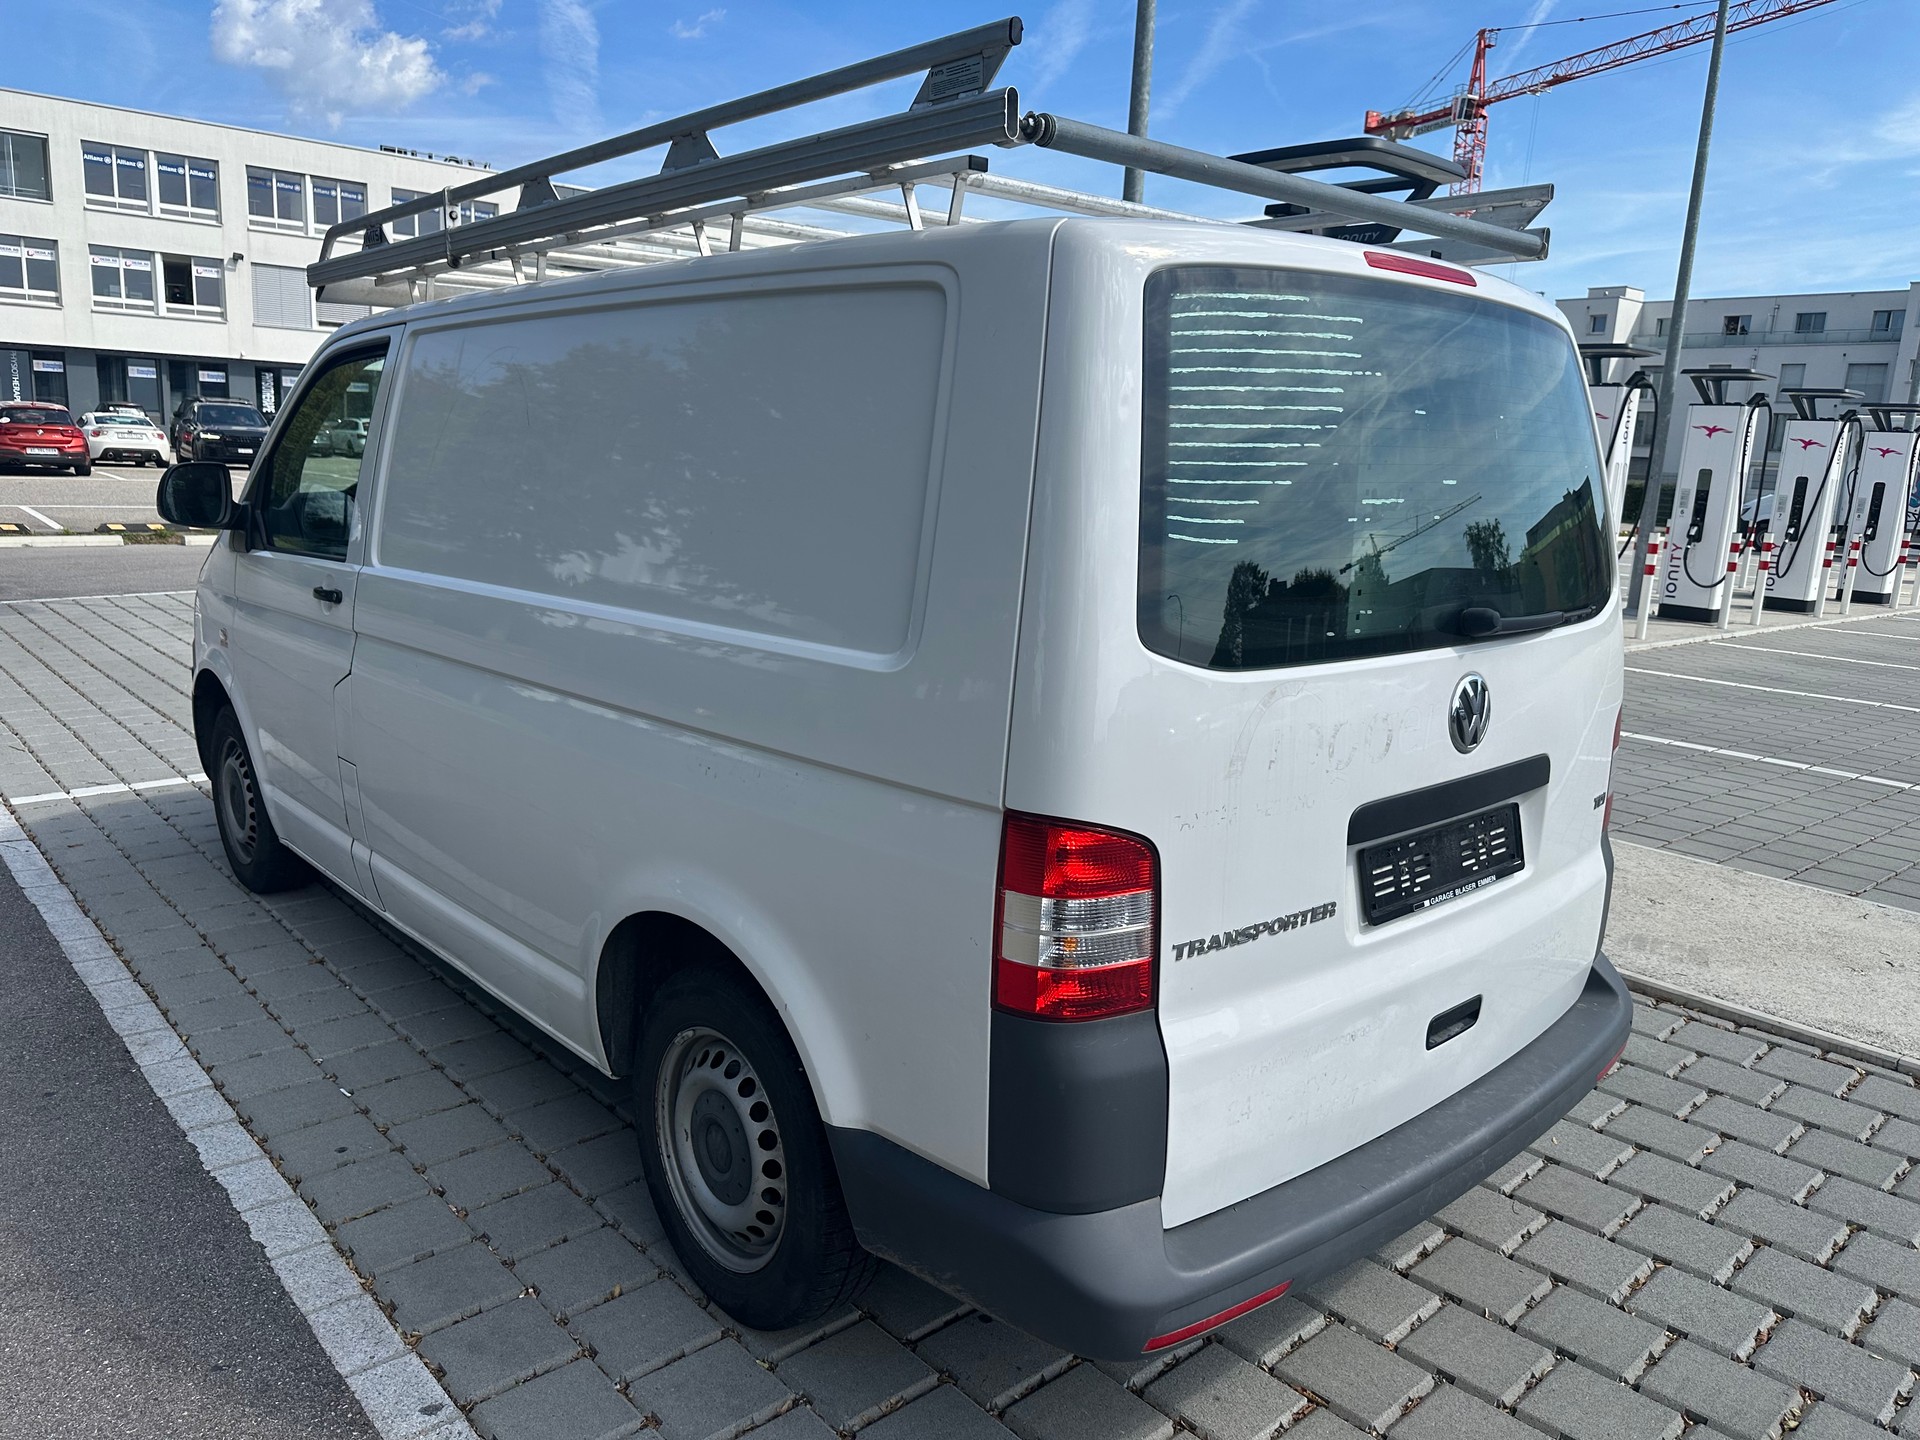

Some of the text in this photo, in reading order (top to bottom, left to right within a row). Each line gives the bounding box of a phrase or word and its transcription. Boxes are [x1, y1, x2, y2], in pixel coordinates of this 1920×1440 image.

[84, 153, 103, 162] Allianz
[117, 158, 136, 167] Allianz
[158, 165, 177, 173] Allianz
[189, 169, 208, 178] Allianz
[276, 182, 294, 191] Allianz
[1665, 543, 1683, 599] IONITY
[1430, 874, 1497, 905] GARAGE BLASER EMMEN
[1171, 900, 1338, 962] TRANSPORTER
